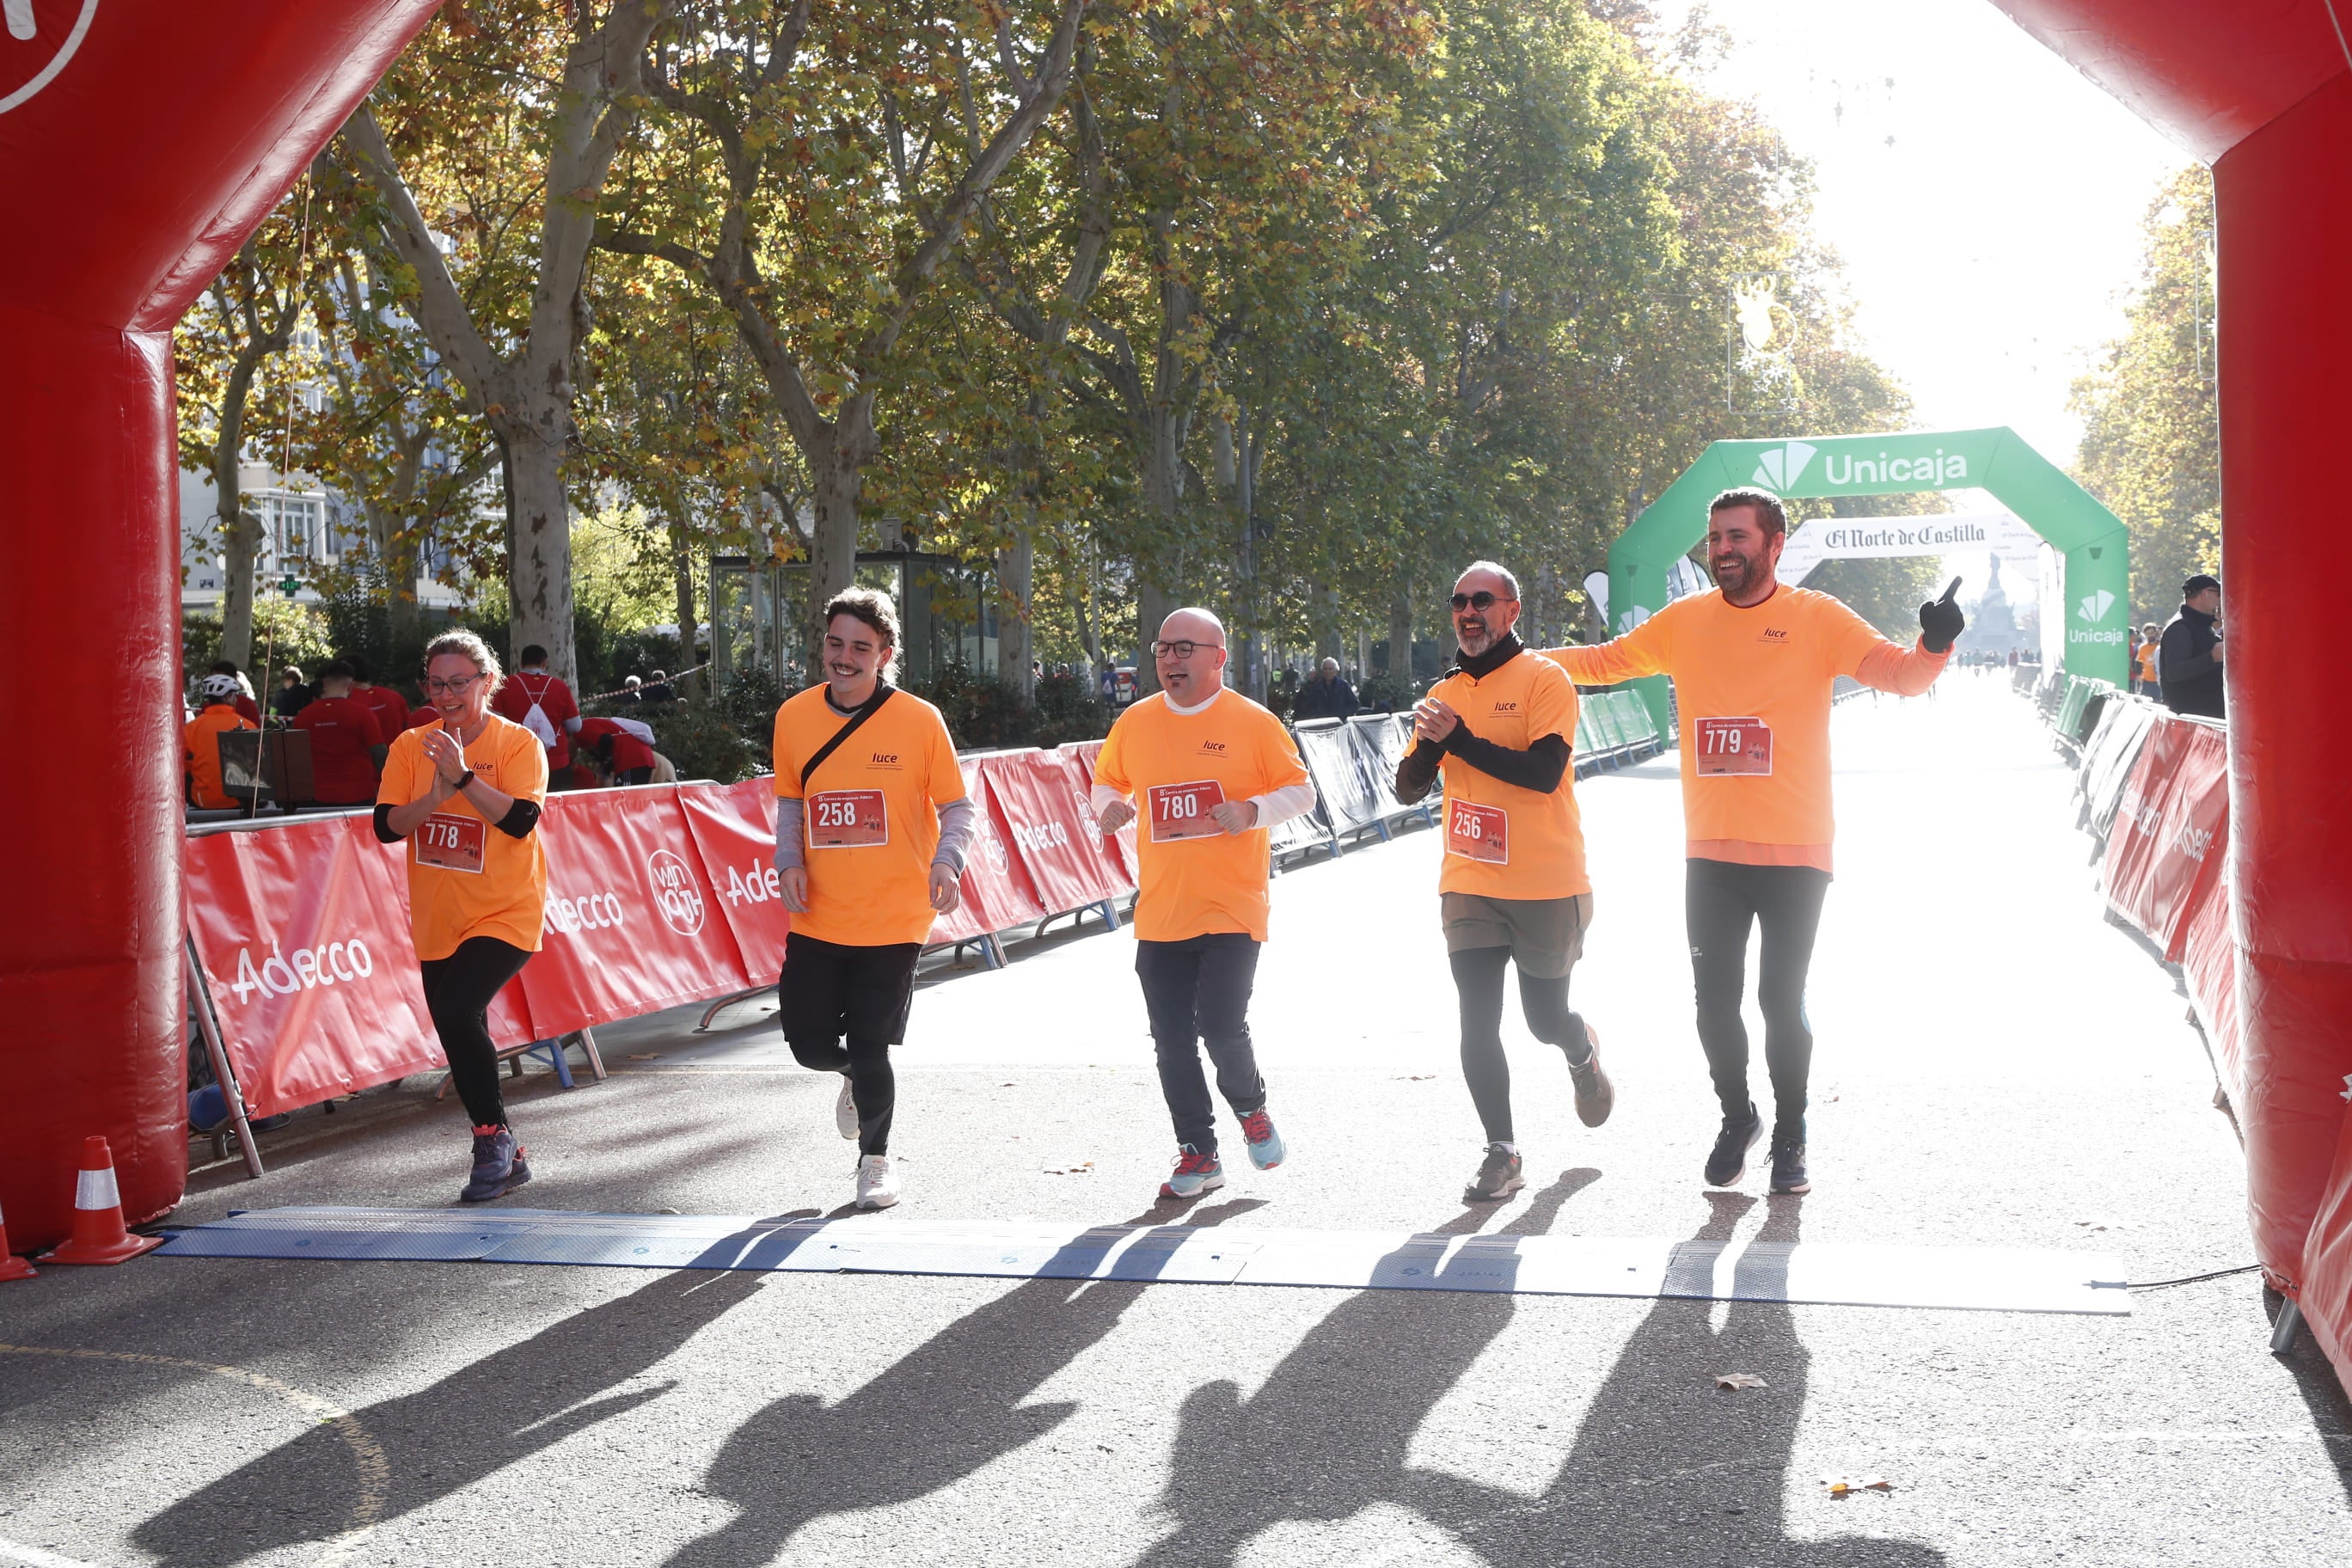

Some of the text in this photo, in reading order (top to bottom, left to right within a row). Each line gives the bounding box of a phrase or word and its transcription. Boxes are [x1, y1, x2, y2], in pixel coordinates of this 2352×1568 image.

[1825, 448, 1968, 486] Unicaja
[1825, 524, 1986, 548] El Norte de Castilla
[1764, 627, 1786, 638] luce
[2069, 628, 2124, 646] Unicaja
[1494, 701, 1516, 711] luce
[1203, 739, 1225, 750] luce
[1705, 729, 1742, 754] 779
[473, 761, 493, 770] luce
[872, 752, 898, 763] luce
[818, 801, 856, 826] 258
[1160, 793, 1197, 821] 780
[426, 823, 459, 848] 778
[1015, 818, 1068, 854] Adecco
[1454, 811, 1481, 840] 256
[726, 858, 781, 907] Ade
[231, 939, 372, 1005] Adecco
